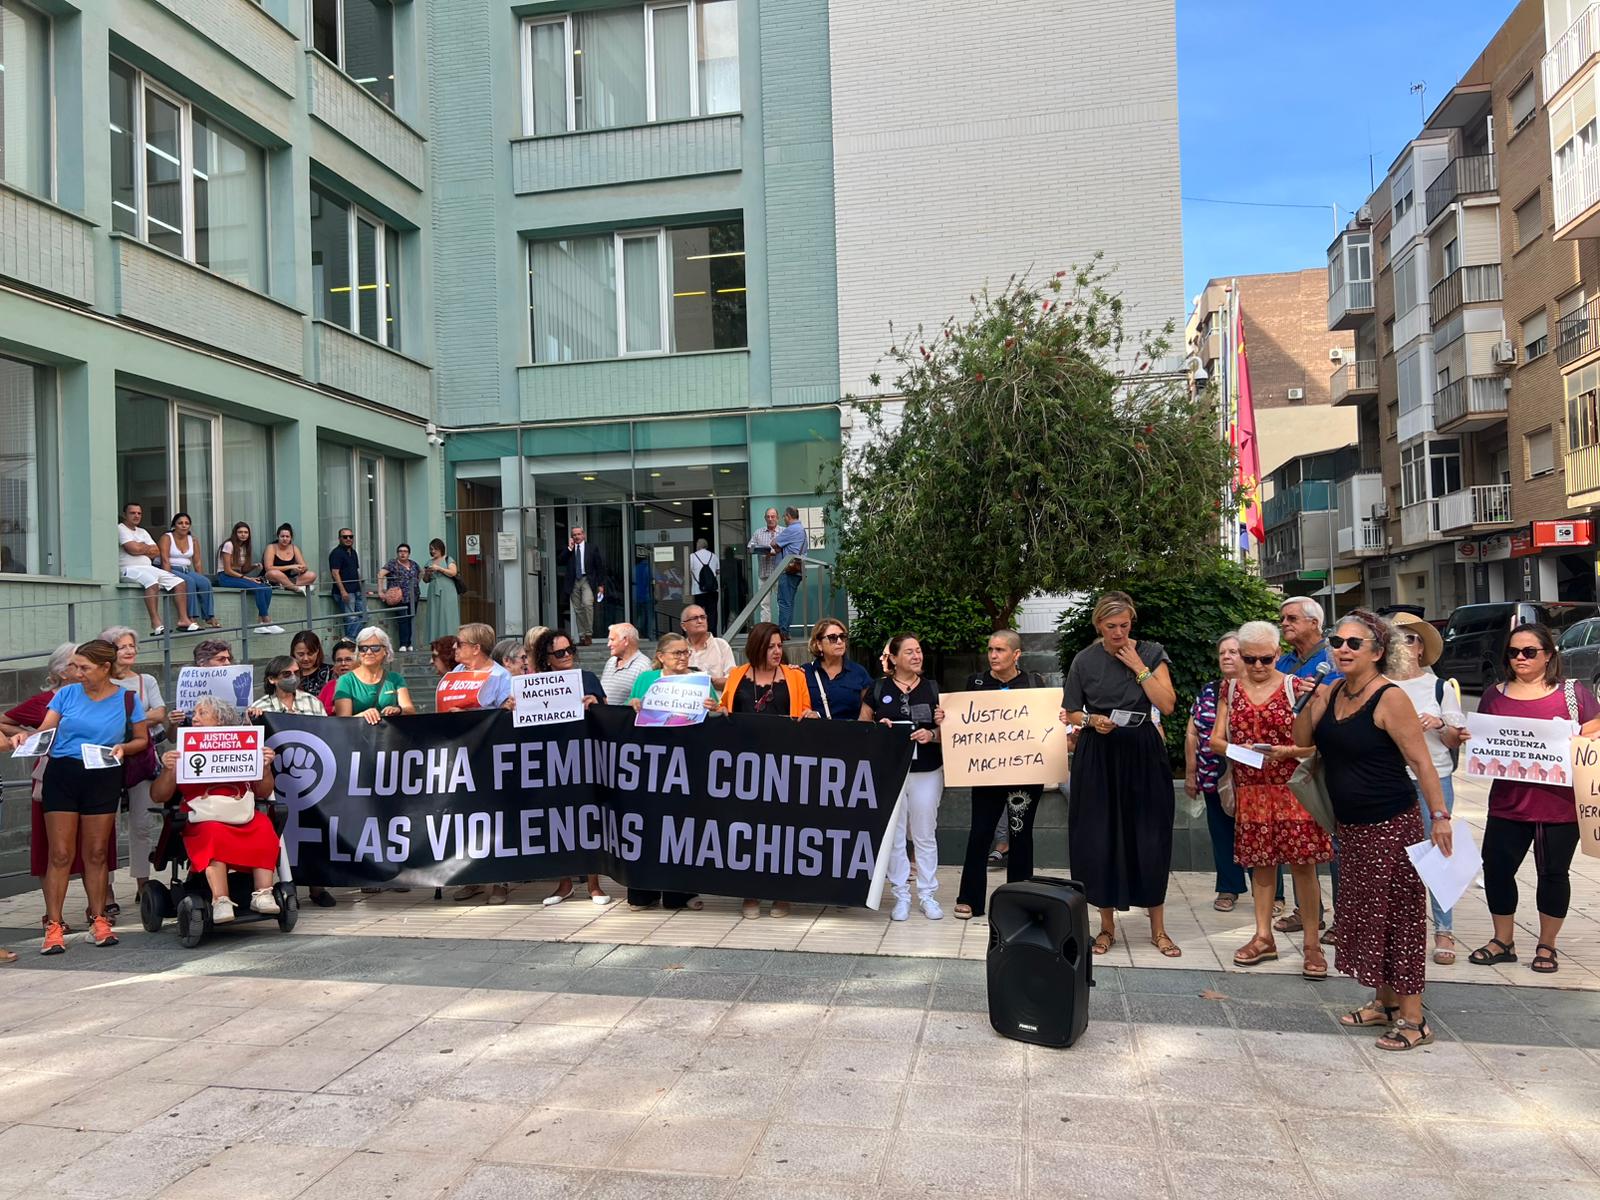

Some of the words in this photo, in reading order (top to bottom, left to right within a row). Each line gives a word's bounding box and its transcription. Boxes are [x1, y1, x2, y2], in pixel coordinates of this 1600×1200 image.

[191, 669, 199, 678] ES
[211, 669, 228, 678] CASO
[180, 680, 208, 688] AISLADO
[524, 675, 565, 689] JUSTICIA
[180, 689, 188, 698] SE
[188, 689, 213, 698] LLAMA
[522, 686, 572, 699] MACHISTA
[671, 684, 680, 695] le
[681, 687, 703, 698] pasa
[543, 701, 549, 709] Y
[671, 699, 700, 711] fiscal?
[519, 710, 577, 723] PATRIARCAL
[961, 700, 1029, 725] JUSTICIA
[203, 732, 239, 742] JUSTICIA
[952, 729, 1035, 748] PATRIARCAL
[1041, 726, 1054, 743] Y
[1499, 728, 1519, 737] QUE
[1521, 730, 1535, 738] LA
[200, 740, 242, 749] MACHISTA
[1486, 737, 1547, 750] VERGÜENZA
[212, 753, 254, 763] DEFENSA
[1472, 747, 1511, 757] CAMBIE
[1512, 750, 1527, 759] DE
[1528, 752, 1563, 763] BANDO
[1575, 743, 1598, 767] NO
[210, 764, 254, 774] FEMINISTA
[968, 752, 1044, 773] MACHISTA
[347, 746, 477, 796] LUCHA
[492, 738, 691, 795] FEMINISTA
[707, 750, 878, 809] CONTRA
[1579, 803, 1600, 819] PER
[329, 815, 411, 863] LAS
[426, 803, 644, 862] VIOLENCIAS
[659, 815, 876, 881] MACHISTA
